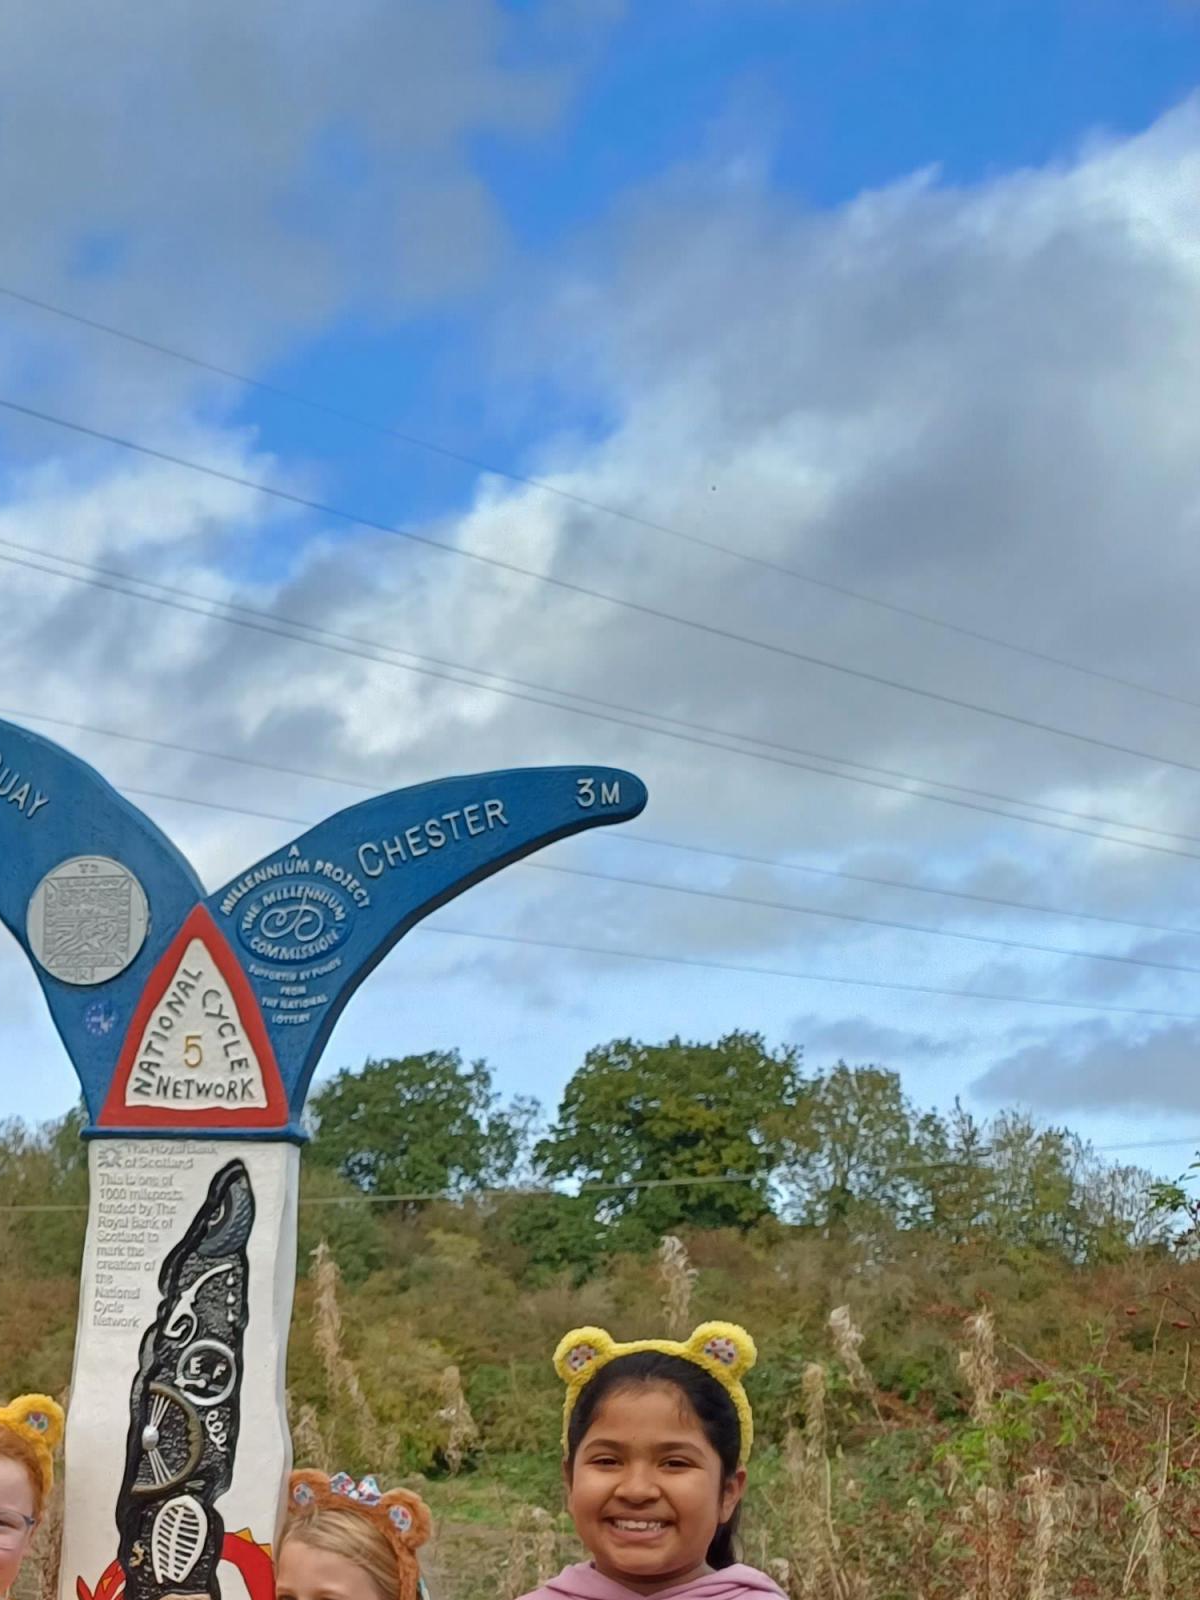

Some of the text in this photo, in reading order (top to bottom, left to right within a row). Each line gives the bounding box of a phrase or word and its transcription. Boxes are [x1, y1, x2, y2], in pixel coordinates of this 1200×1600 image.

[357, 777, 621, 878] CHESTER 3 M
[288, 845, 300, 857] A
[219, 859, 371, 916] MILLENNIUM PROJECT
[241, 886, 346, 931] THE MILLENNIUM
[250, 929, 340, 960] COMMISSION
[133, 968, 203, 1097] NATIONAL
[201, 989, 249, 1072] CYCLE
[184, 1035, 203, 1068] 5
[156, 1075, 256, 1100] NETWORK
[139, 1203, 153, 1216] by
[97, 1217, 129, 1231] Royal
[161, 1217, 173, 1229] of
[95, 1287, 140, 1299] National
[94, 1302, 124, 1315] Cycle
[93, 1316, 141, 1328] Network
[190, 1355, 204, 1375] E
